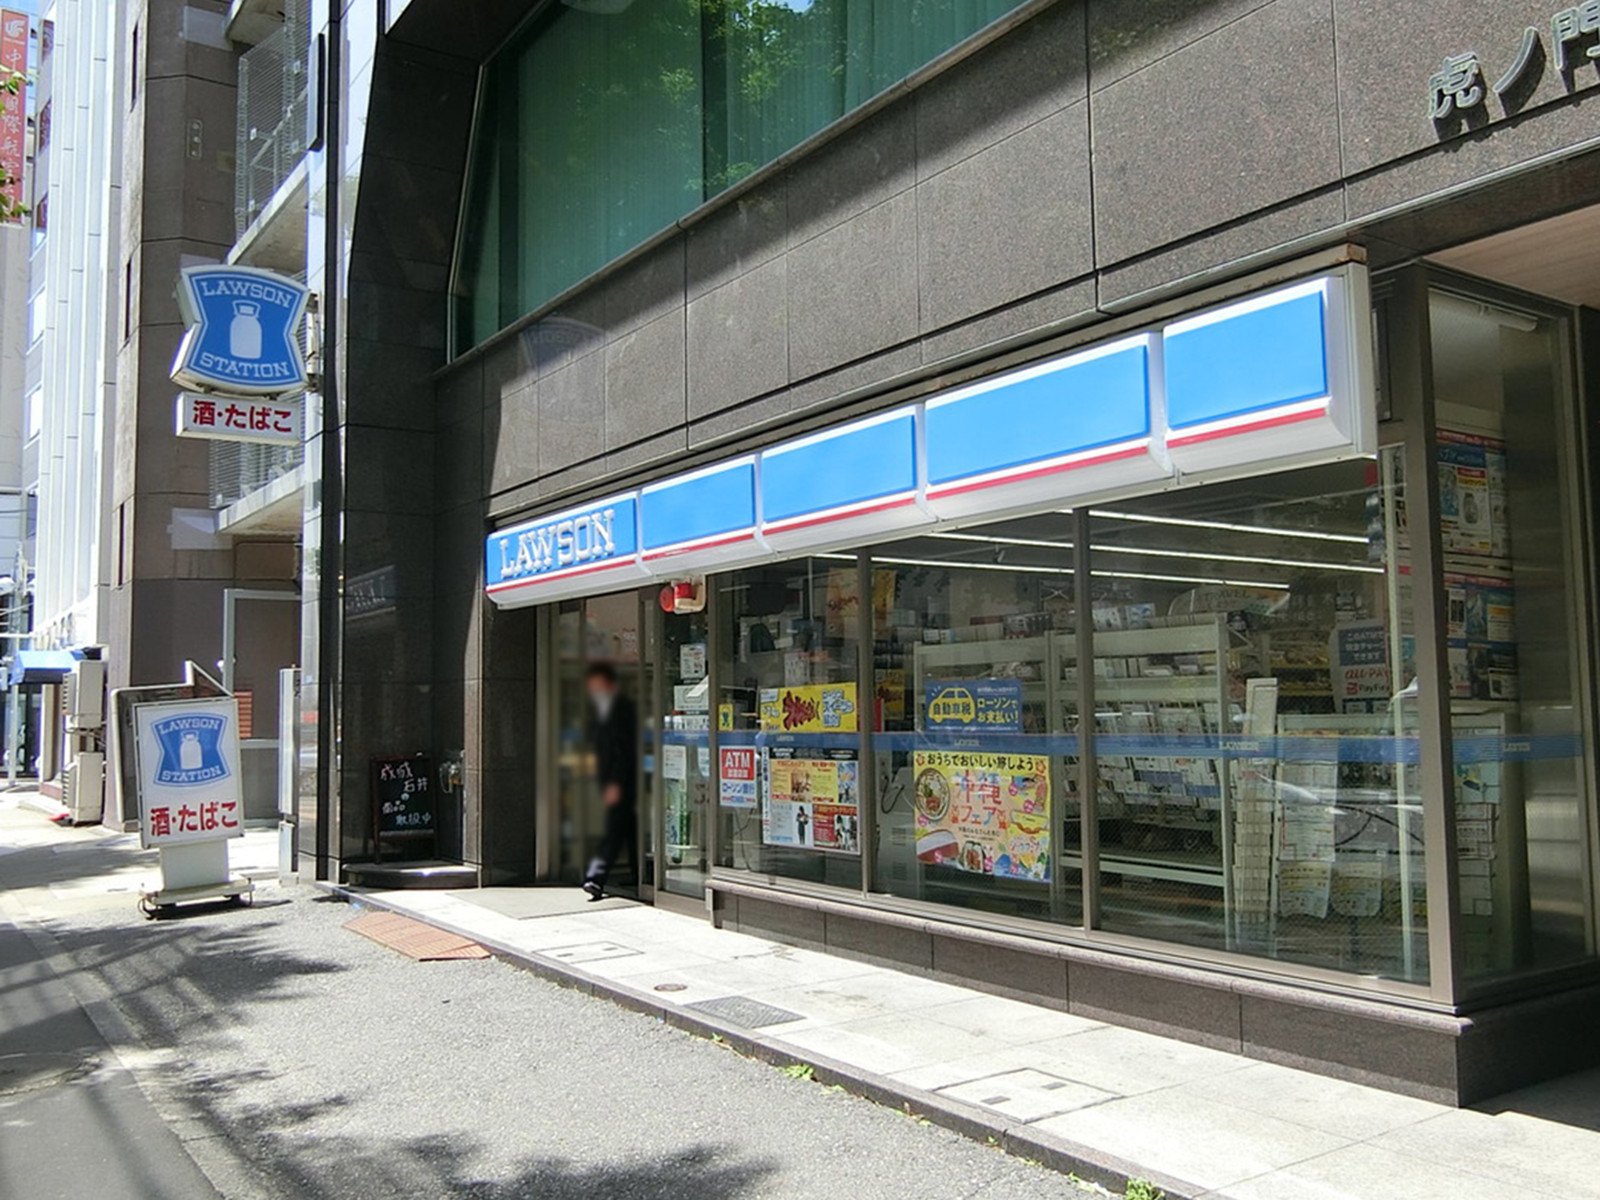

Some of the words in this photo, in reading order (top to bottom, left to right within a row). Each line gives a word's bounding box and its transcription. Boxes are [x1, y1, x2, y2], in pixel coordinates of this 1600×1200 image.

[201, 280, 293, 308] LAWSON
[200, 351, 290, 378] STATION
[193, 400, 292, 433] 酒・たばこ
[499, 508, 615, 578] LAWSON
[977, 697, 1018, 709] ローソンで
[158, 719, 221, 735] LAWSON
[725, 751, 751, 769] ATM
[161, 765, 222, 782] STATION
[150, 801, 238, 837] 酒・たばこ
[961, 805, 997, 826] フェア
